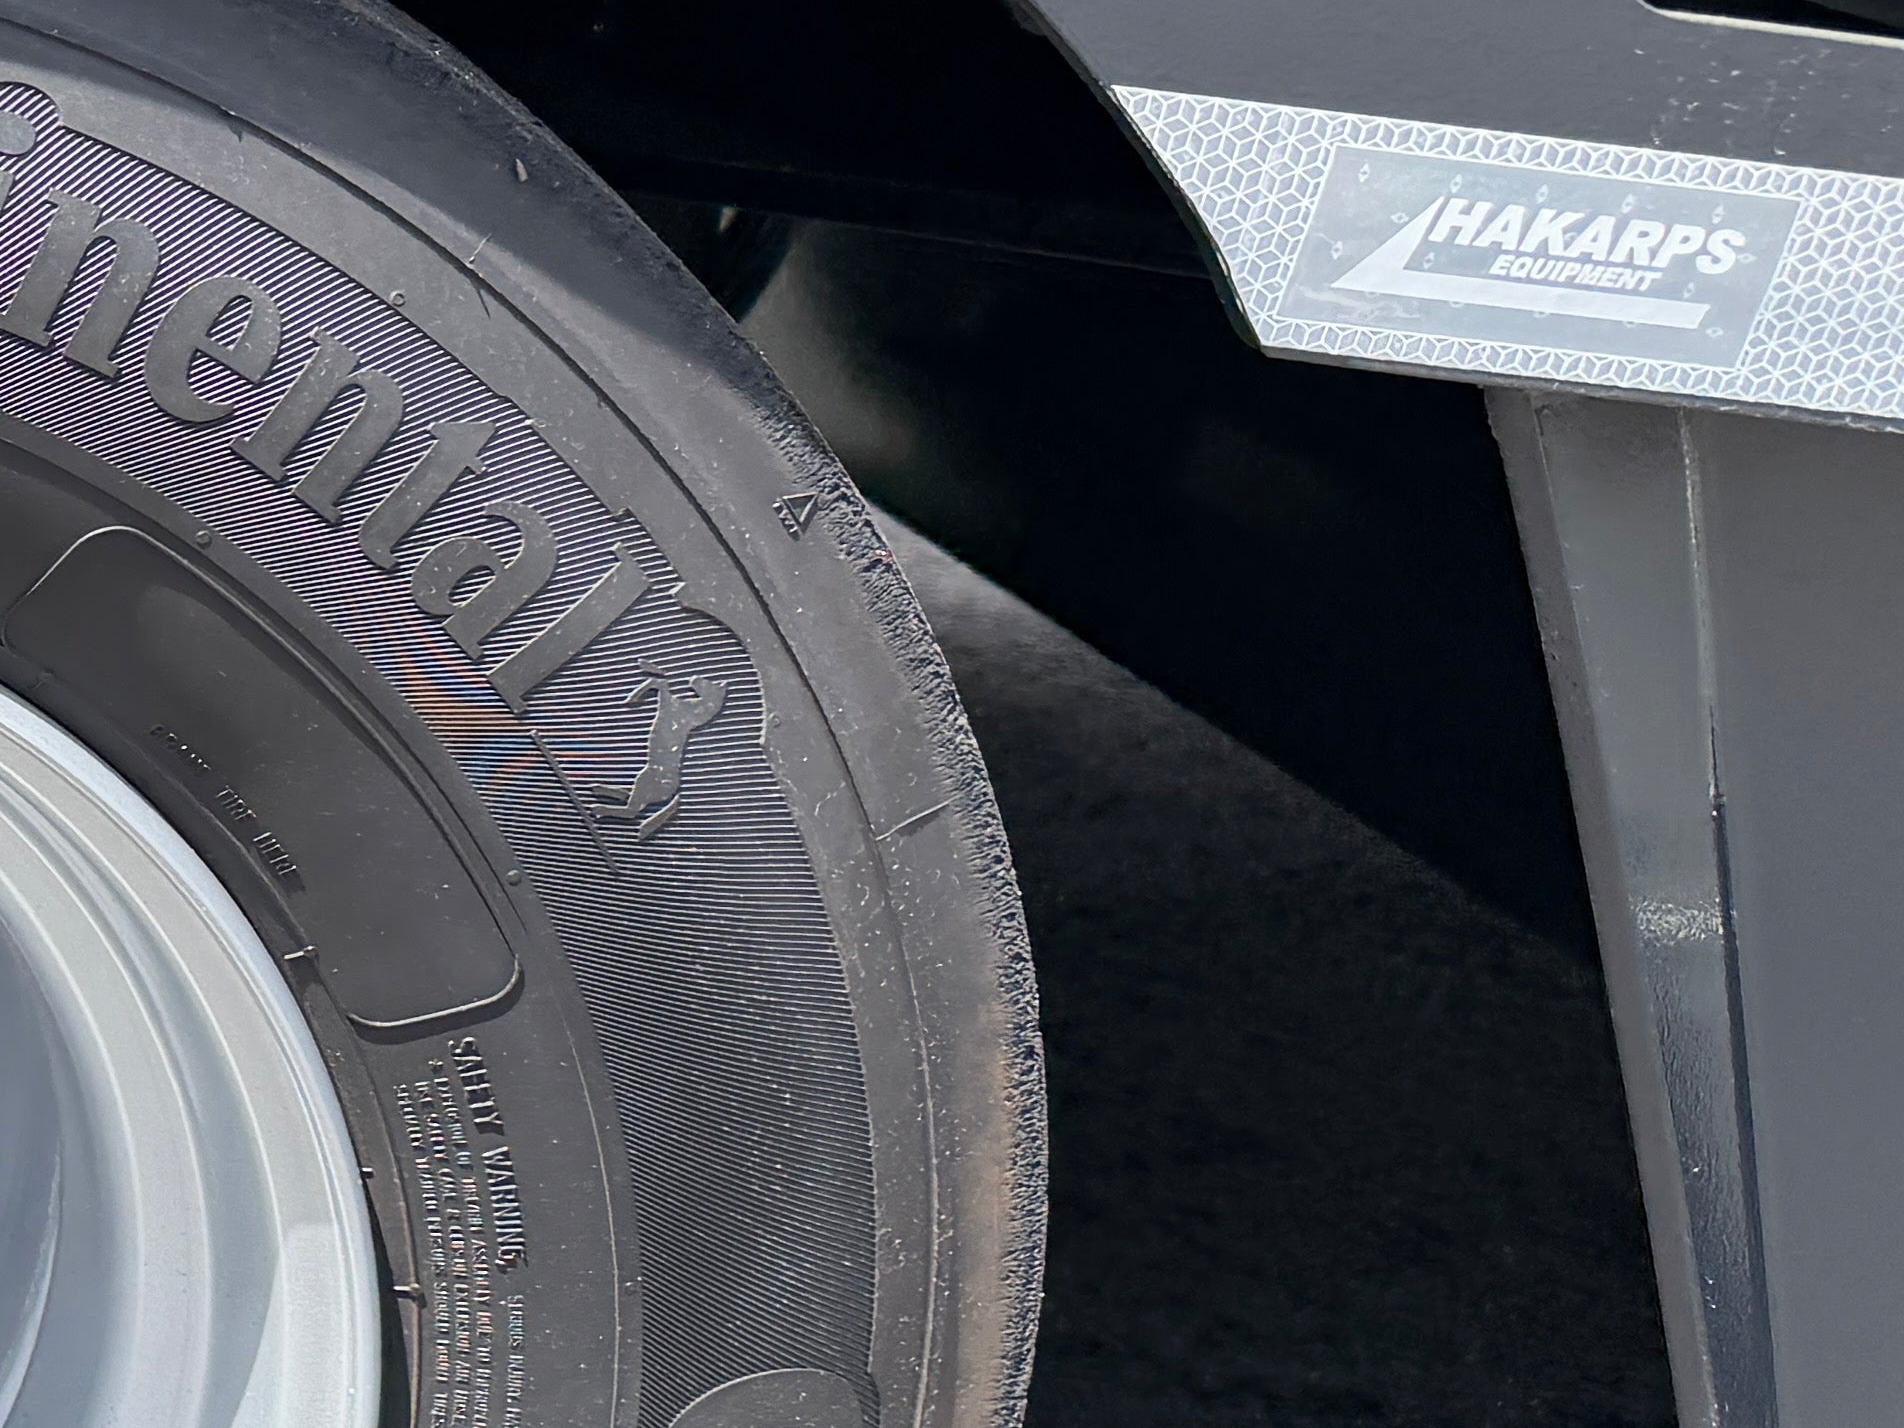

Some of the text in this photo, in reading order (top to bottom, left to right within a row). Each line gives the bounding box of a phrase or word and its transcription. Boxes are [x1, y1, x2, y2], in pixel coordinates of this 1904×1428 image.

[1429, 198, 1746, 276] HAKARPS
[1489, 254, 1663, 292] EQUIPMENT
[446, 1030, 504, 1137] SAFETY
